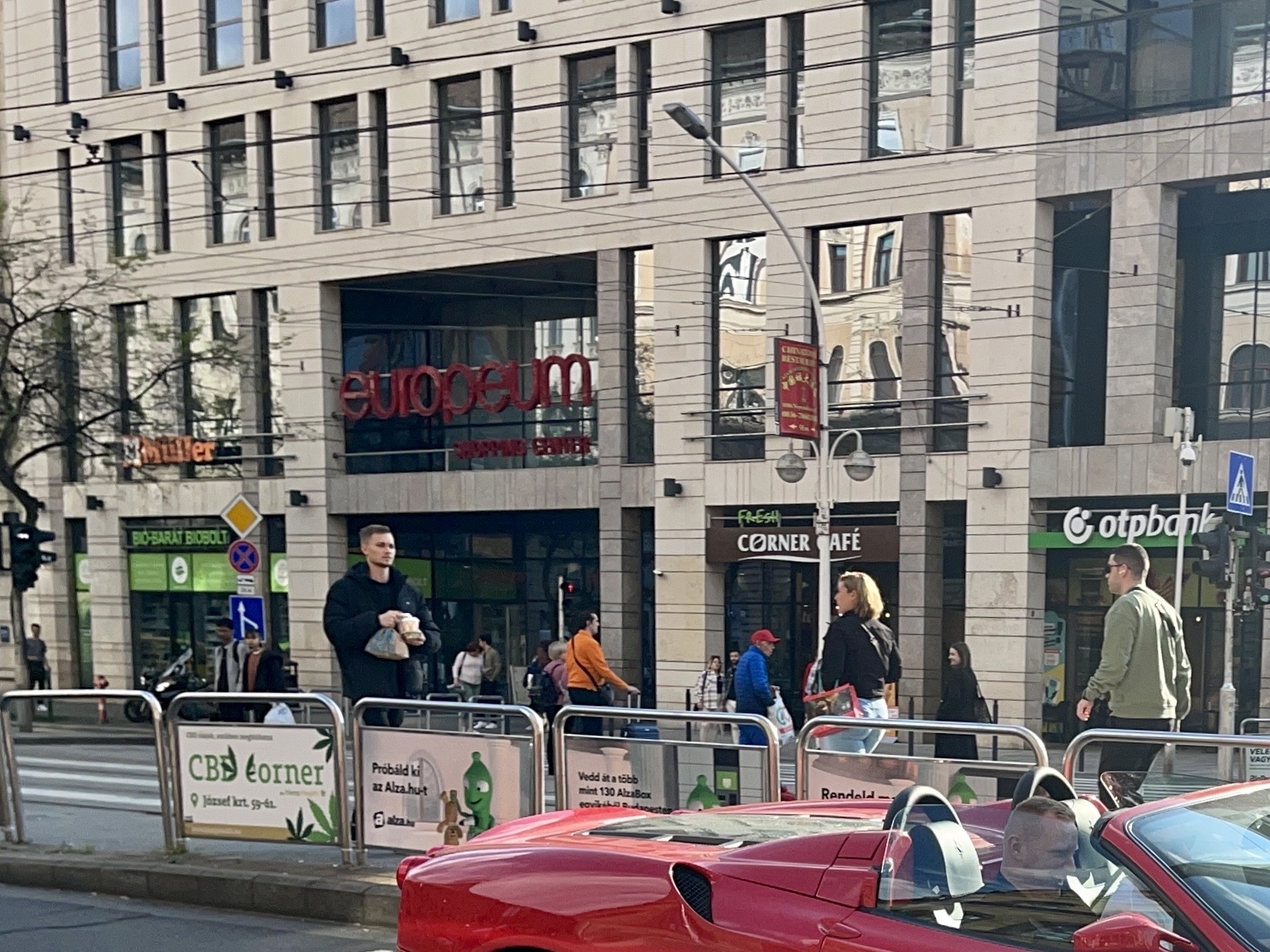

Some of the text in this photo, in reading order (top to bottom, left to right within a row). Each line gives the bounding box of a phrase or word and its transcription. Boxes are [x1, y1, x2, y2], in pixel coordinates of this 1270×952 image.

[339, 353, 592, 423] europeum
[1098, 502, 1217, 545] otpbank
[817, 528, 862, 552] AFÉ
[188, 747, 238, 782] CBD
[372, 762, 421, 777] Próbáld ki
[578, 771, 600, 783] Vedd
[601, 773, 610, 783] át
[618, 774, 639, 785] több
[372, 781, 428, 797] az Alza.hu-t
[578, 786, 652, 799] mint 130 AlzaBox
[821, 788, 875, 800] Rendeld
[202, 794, 231, 809] József
[232, 796, 250, 808] krt.
